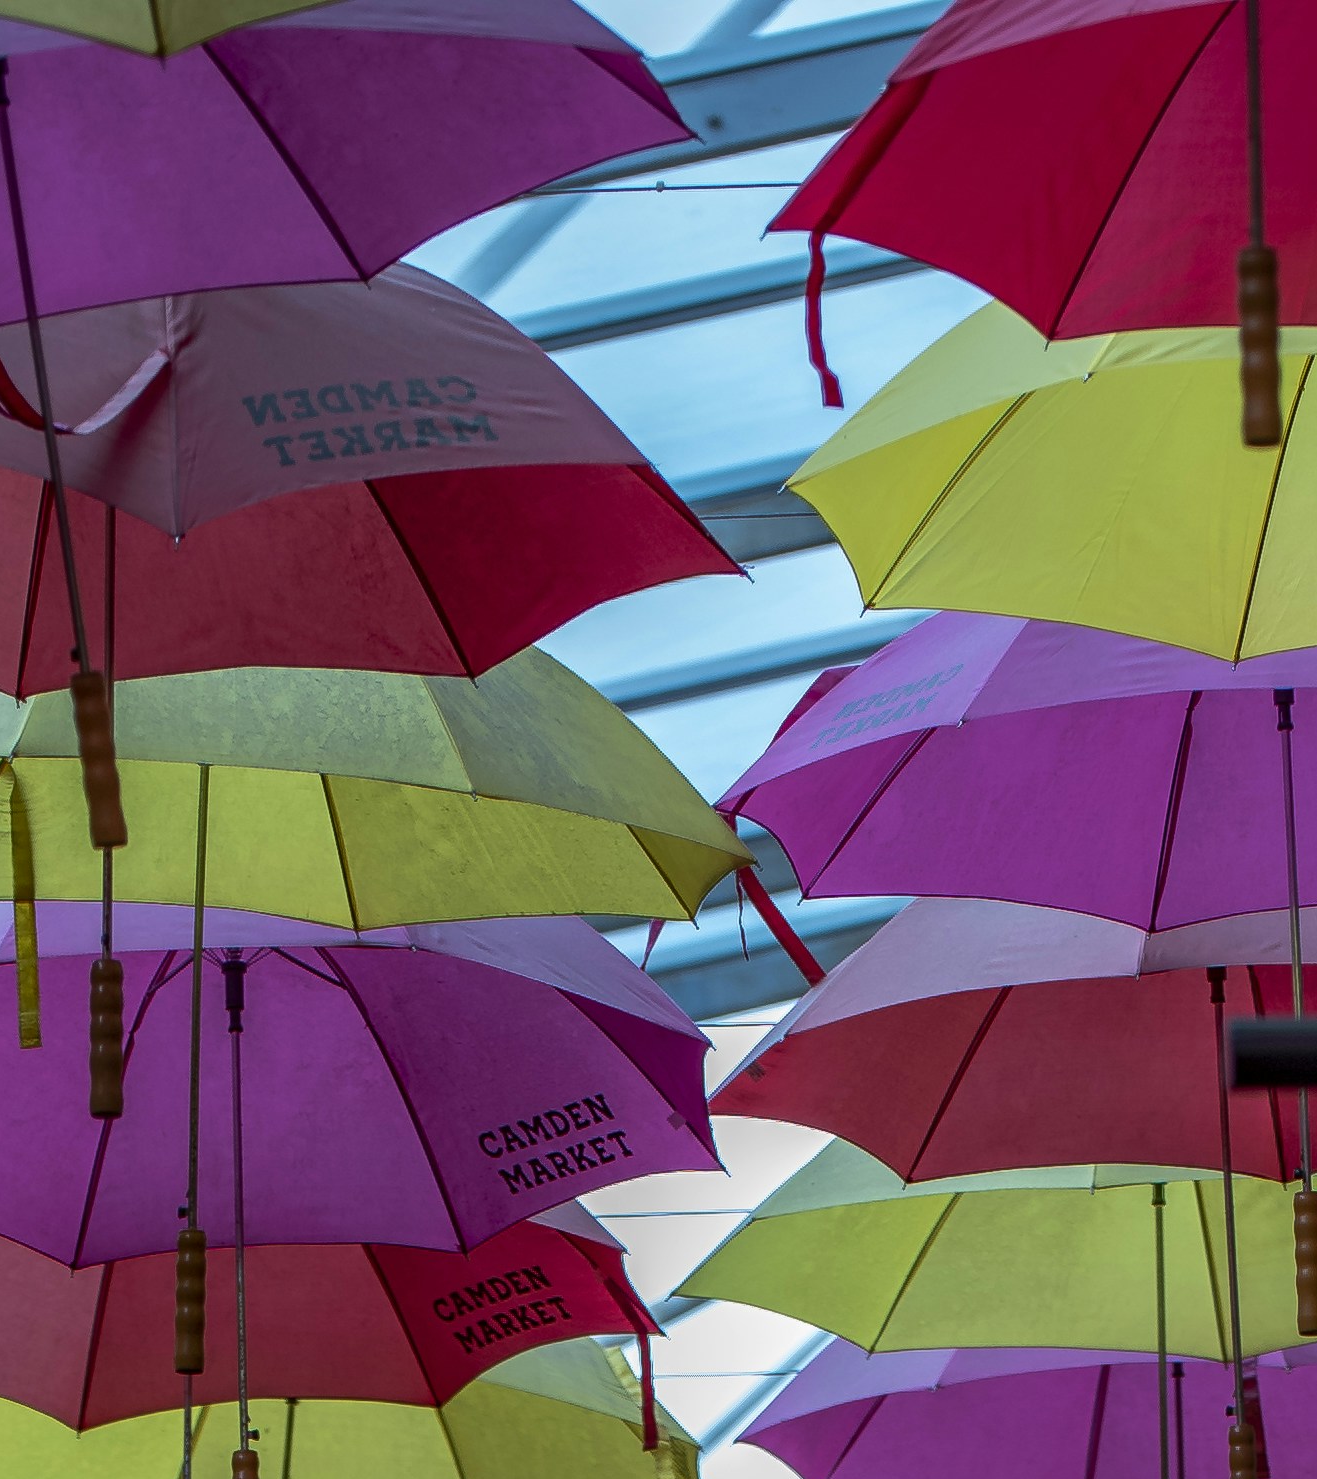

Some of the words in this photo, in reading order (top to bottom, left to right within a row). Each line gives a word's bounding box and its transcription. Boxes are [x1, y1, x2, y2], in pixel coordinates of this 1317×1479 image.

[478, 1093, 615, 1158] CAMDEN
[498, 1130, 634, 1195] MARKET
[433, 1265, 552, 1323] CAMDEN
[453, 1296, 573, 1354] MARKET
